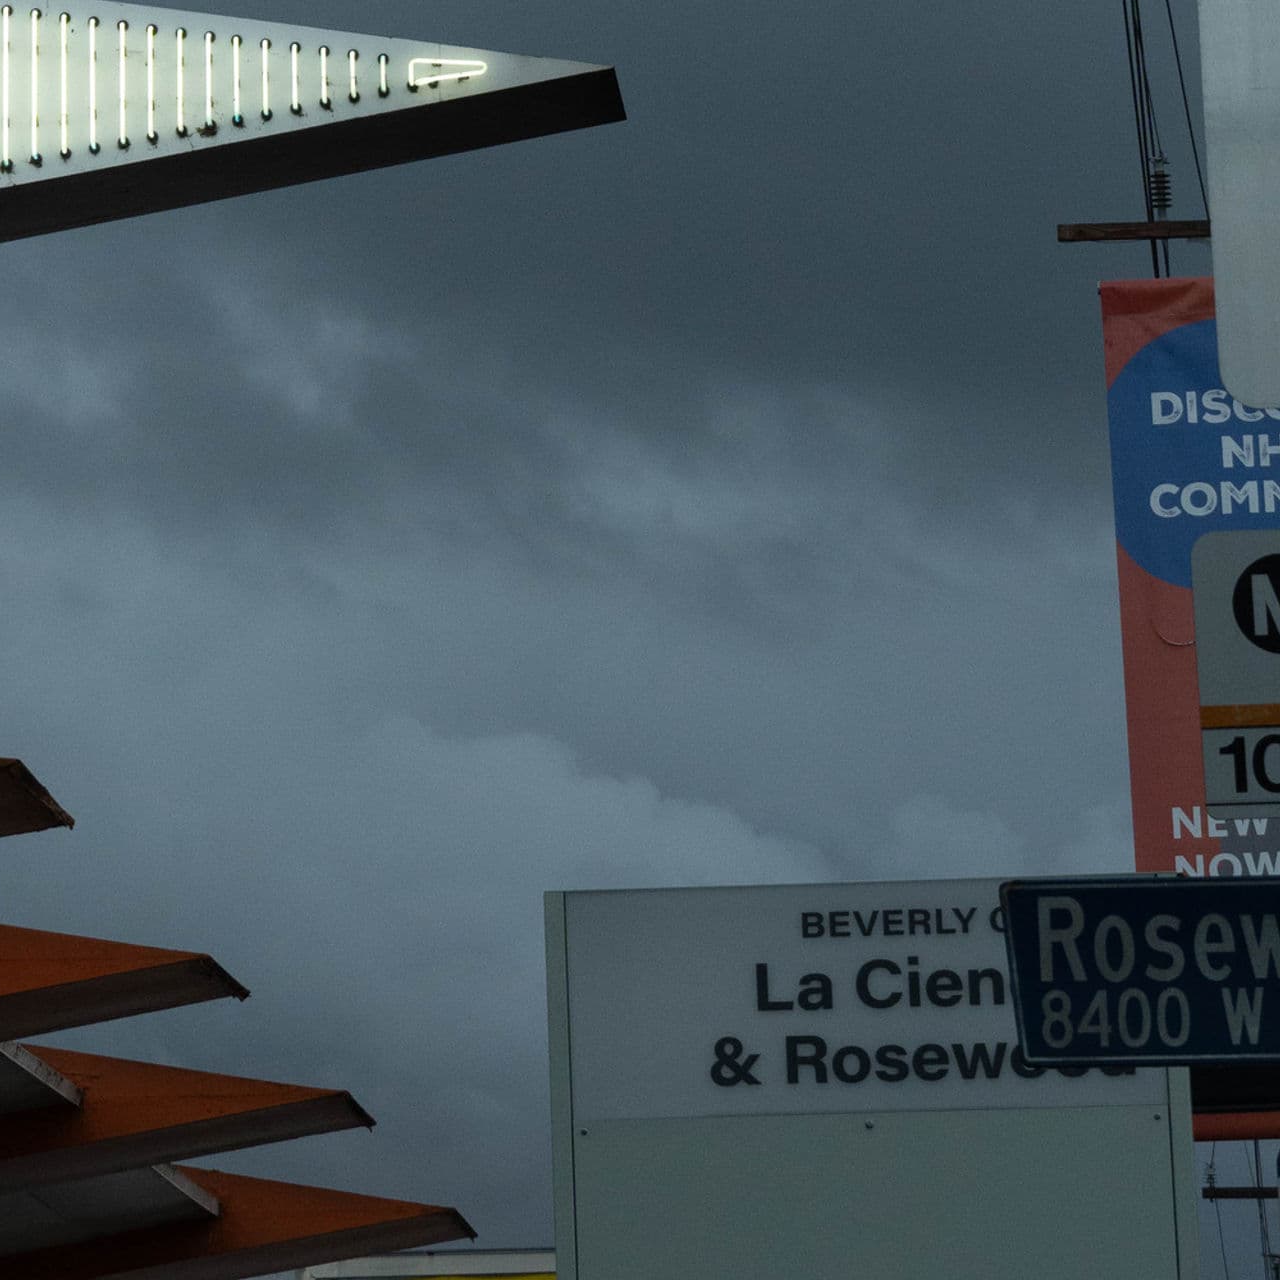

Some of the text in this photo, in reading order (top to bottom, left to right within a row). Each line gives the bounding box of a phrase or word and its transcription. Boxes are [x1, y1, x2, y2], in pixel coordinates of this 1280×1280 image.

[1151, 390, 1280, 424] DISC
[801, 907, 977, 938] BEVERLY
[755, 957, 834, 1012] La
[1041, 986, 1265, 1049] 8400 W
[710, 1036, 1138, 1087] & Rosew
